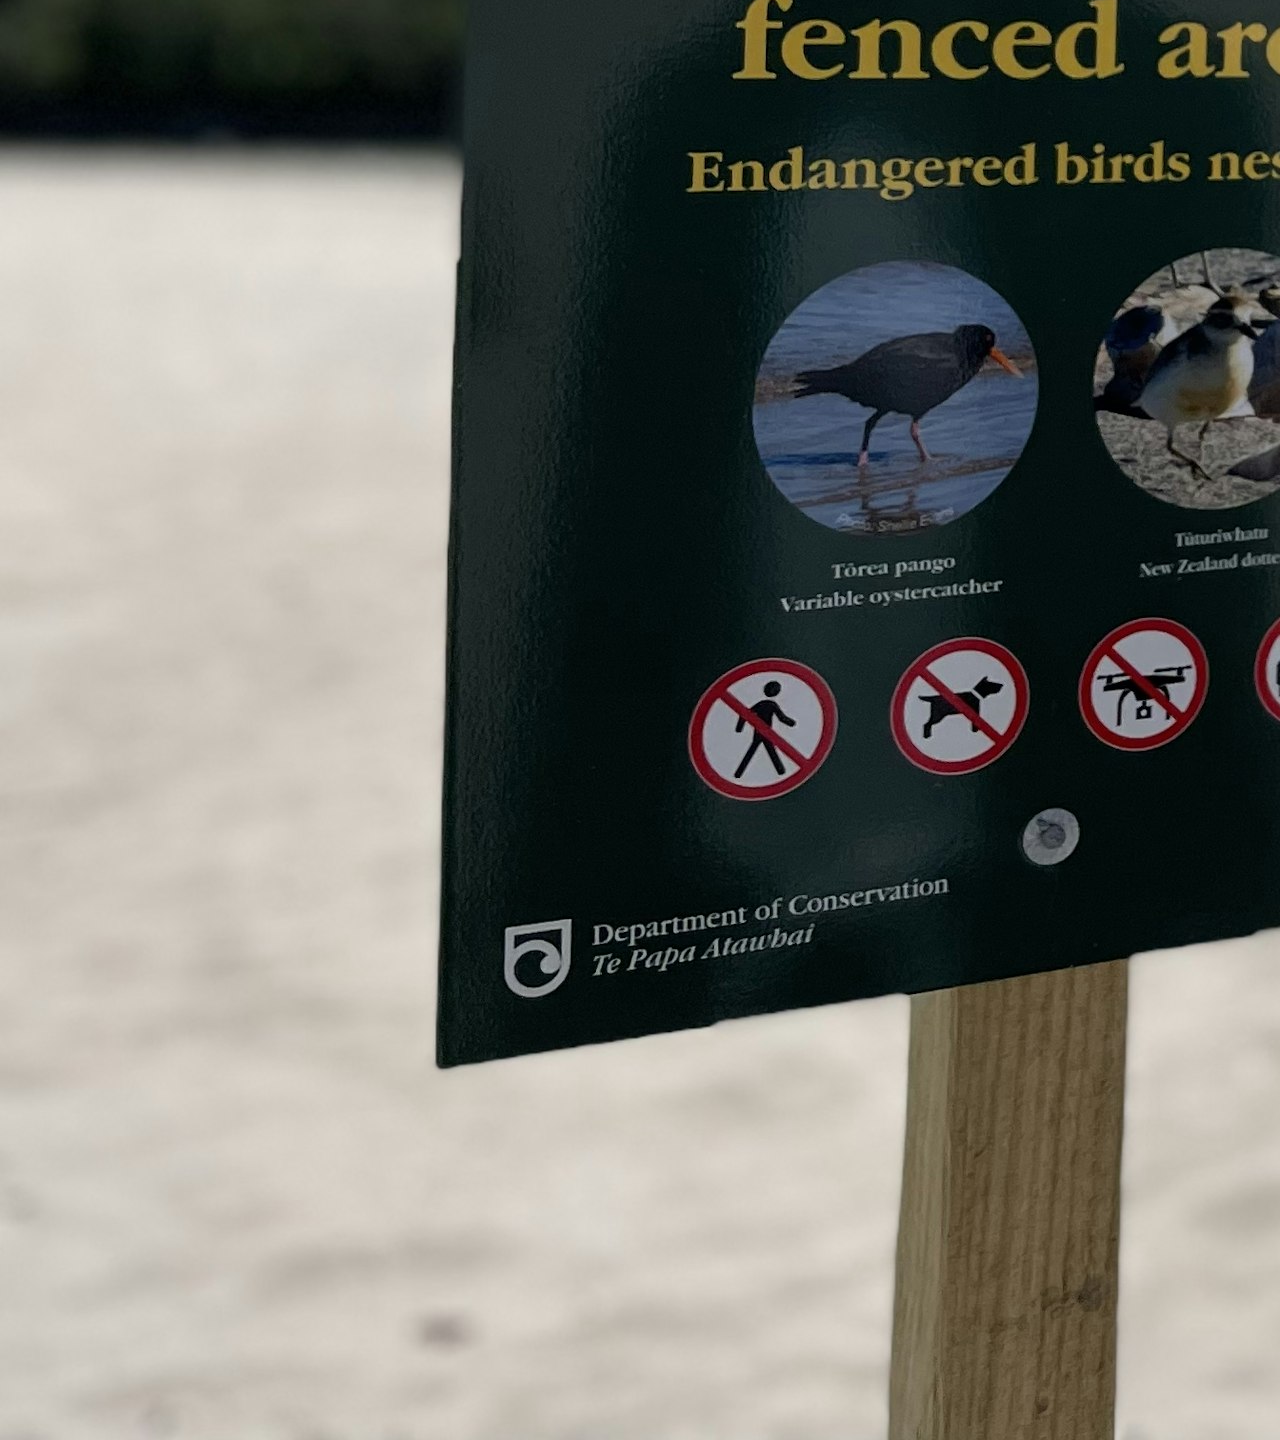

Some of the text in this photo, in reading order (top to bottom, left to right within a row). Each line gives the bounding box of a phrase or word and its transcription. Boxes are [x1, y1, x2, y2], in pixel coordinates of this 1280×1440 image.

[686, 143, 1039, 202] Endangered
[1056, 139, 1192, 187] birds
[893, 557, 956, 578] pango
[1139, 561, 1174, 578] New
[1177, 553, 1239, 574] Zealand
[780, 578, 1004, 613] Variable oystercatcher
[592, 877, 950, 947] Department of Conservation
[592, 922, 816, 976] Te Papa Atawhai
